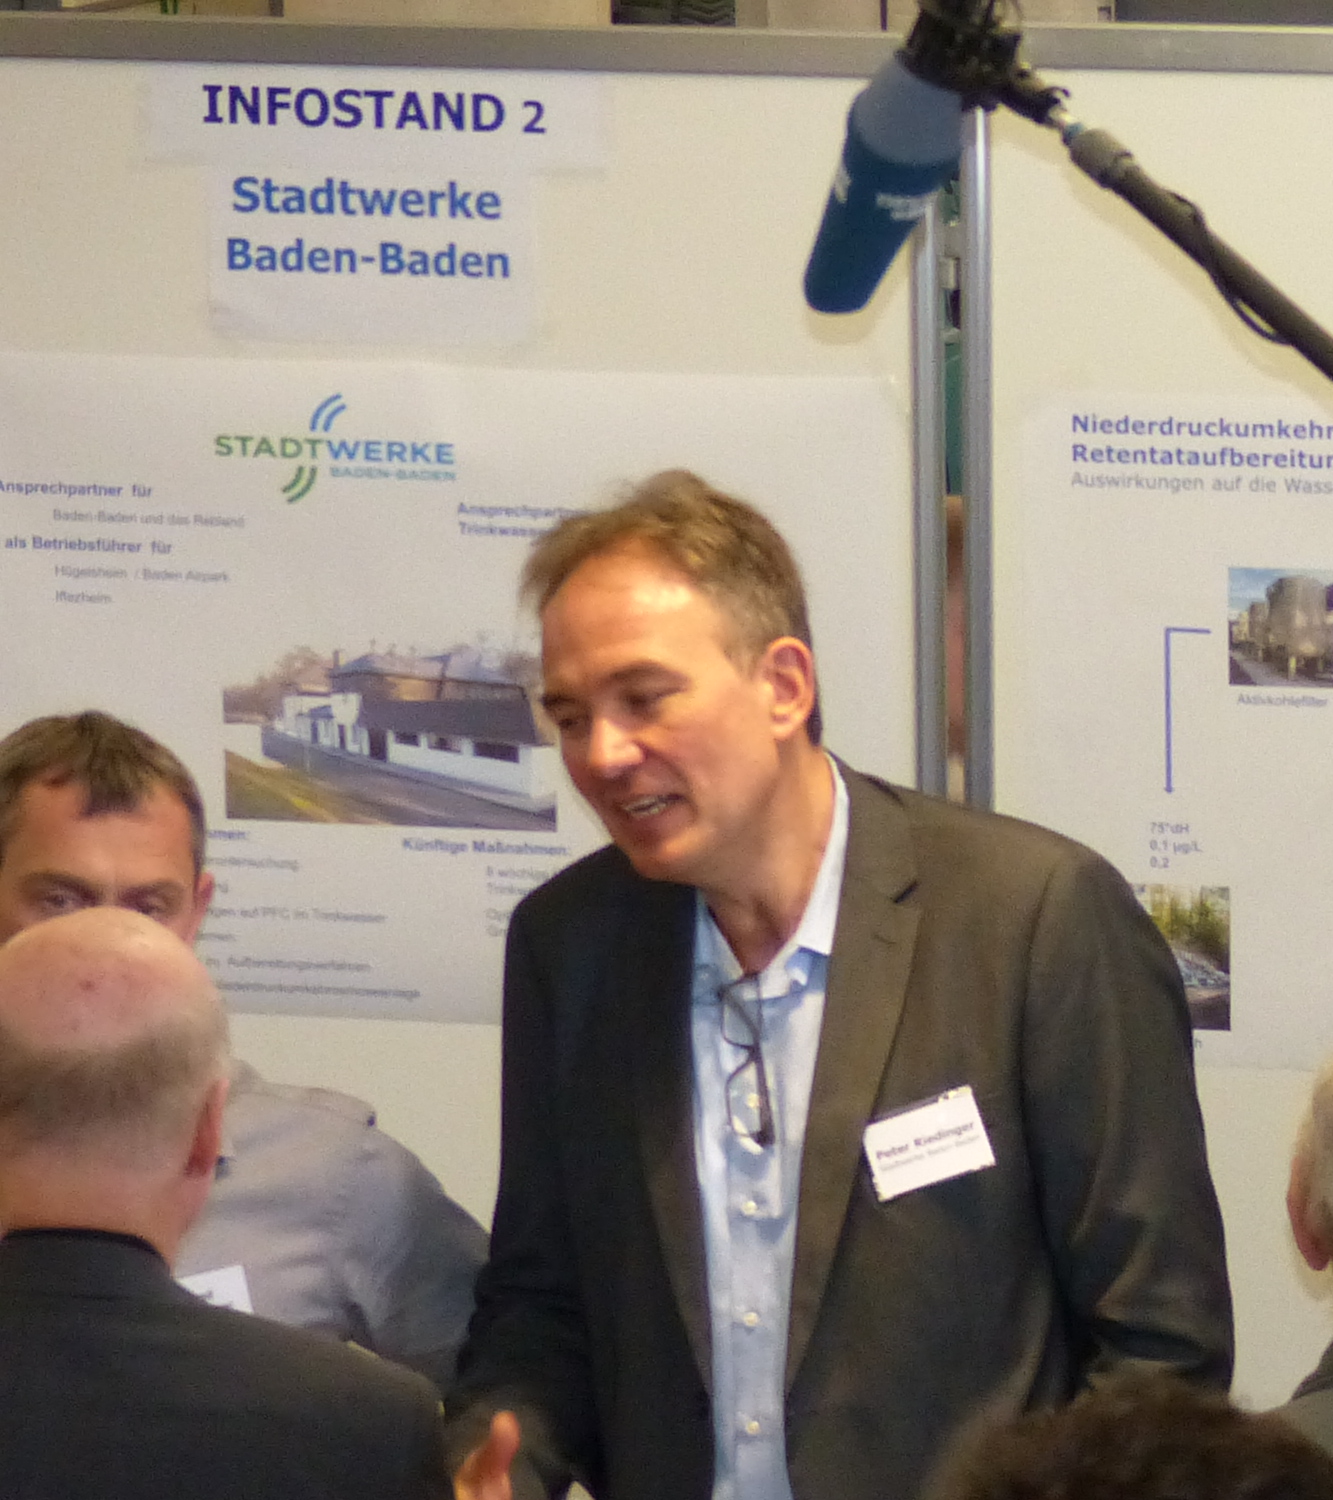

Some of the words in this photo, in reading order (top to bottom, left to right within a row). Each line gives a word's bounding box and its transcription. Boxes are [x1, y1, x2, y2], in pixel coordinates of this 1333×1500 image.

[202, 84, 506, 134] INFOSTAND
[521, 99, 548, 135] 2
[231, 175, 503, 220] Stadtwerke
[226, 237, 511, 280] Baden-Baden
[214, 434, 455, 466] STADTWERKE
[131, 483, 154, 498] für
[1071, 472, 1204, 494] Auswirkungen
[1212, 476, 1242, 492] auf
[1249, 477, 1277, 493] die
[5, 536, 27, 550] als
[32, 536, 142, 554] Betriebsführer
[151, 540, 173, 555] für
